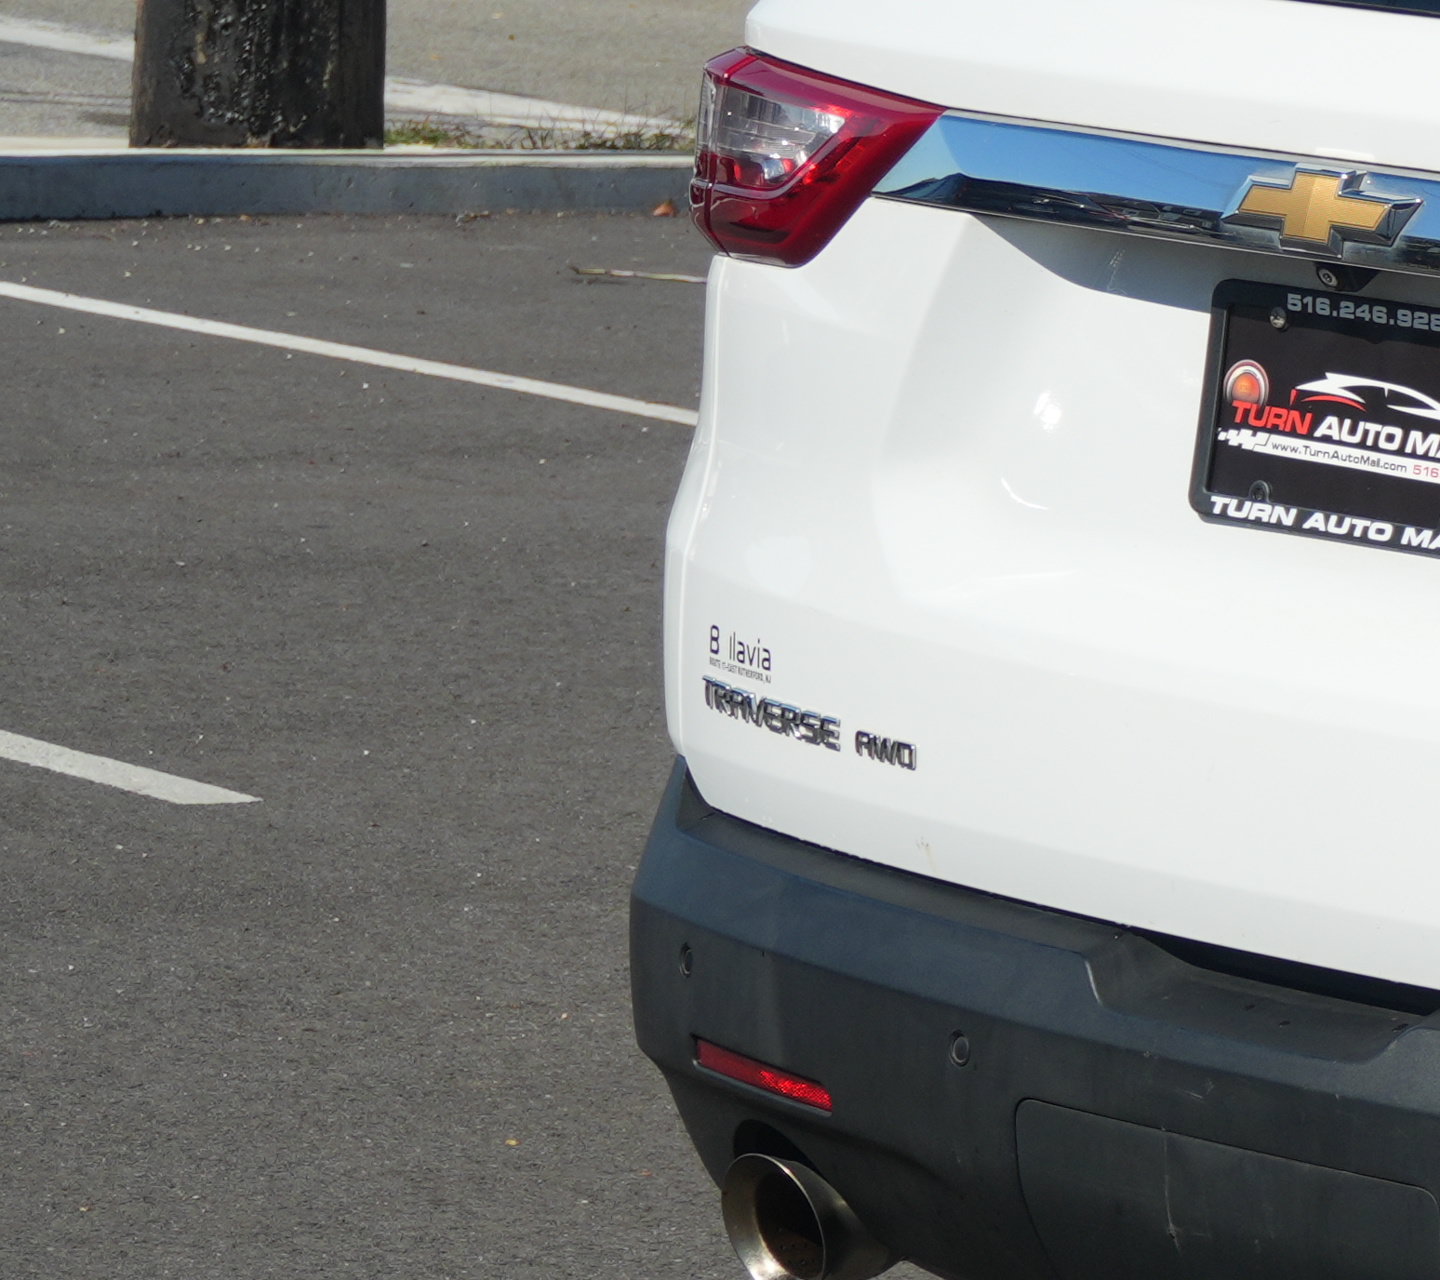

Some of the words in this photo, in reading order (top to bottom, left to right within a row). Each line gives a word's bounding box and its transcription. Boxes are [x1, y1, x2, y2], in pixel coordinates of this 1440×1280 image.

[1232, 400, 1314, 436] TURN
[1314, 415, 1402, 452] AUTO
[1271, 442, 1407, 474] www.TurnAutoMall.com
[1211, 496, 1297, 526] TURN
[1302, 511, 1392, 541] AUTO
[702, 675, 841, 752] TRAVERSE
[855, 730, 918, 771] AWD
